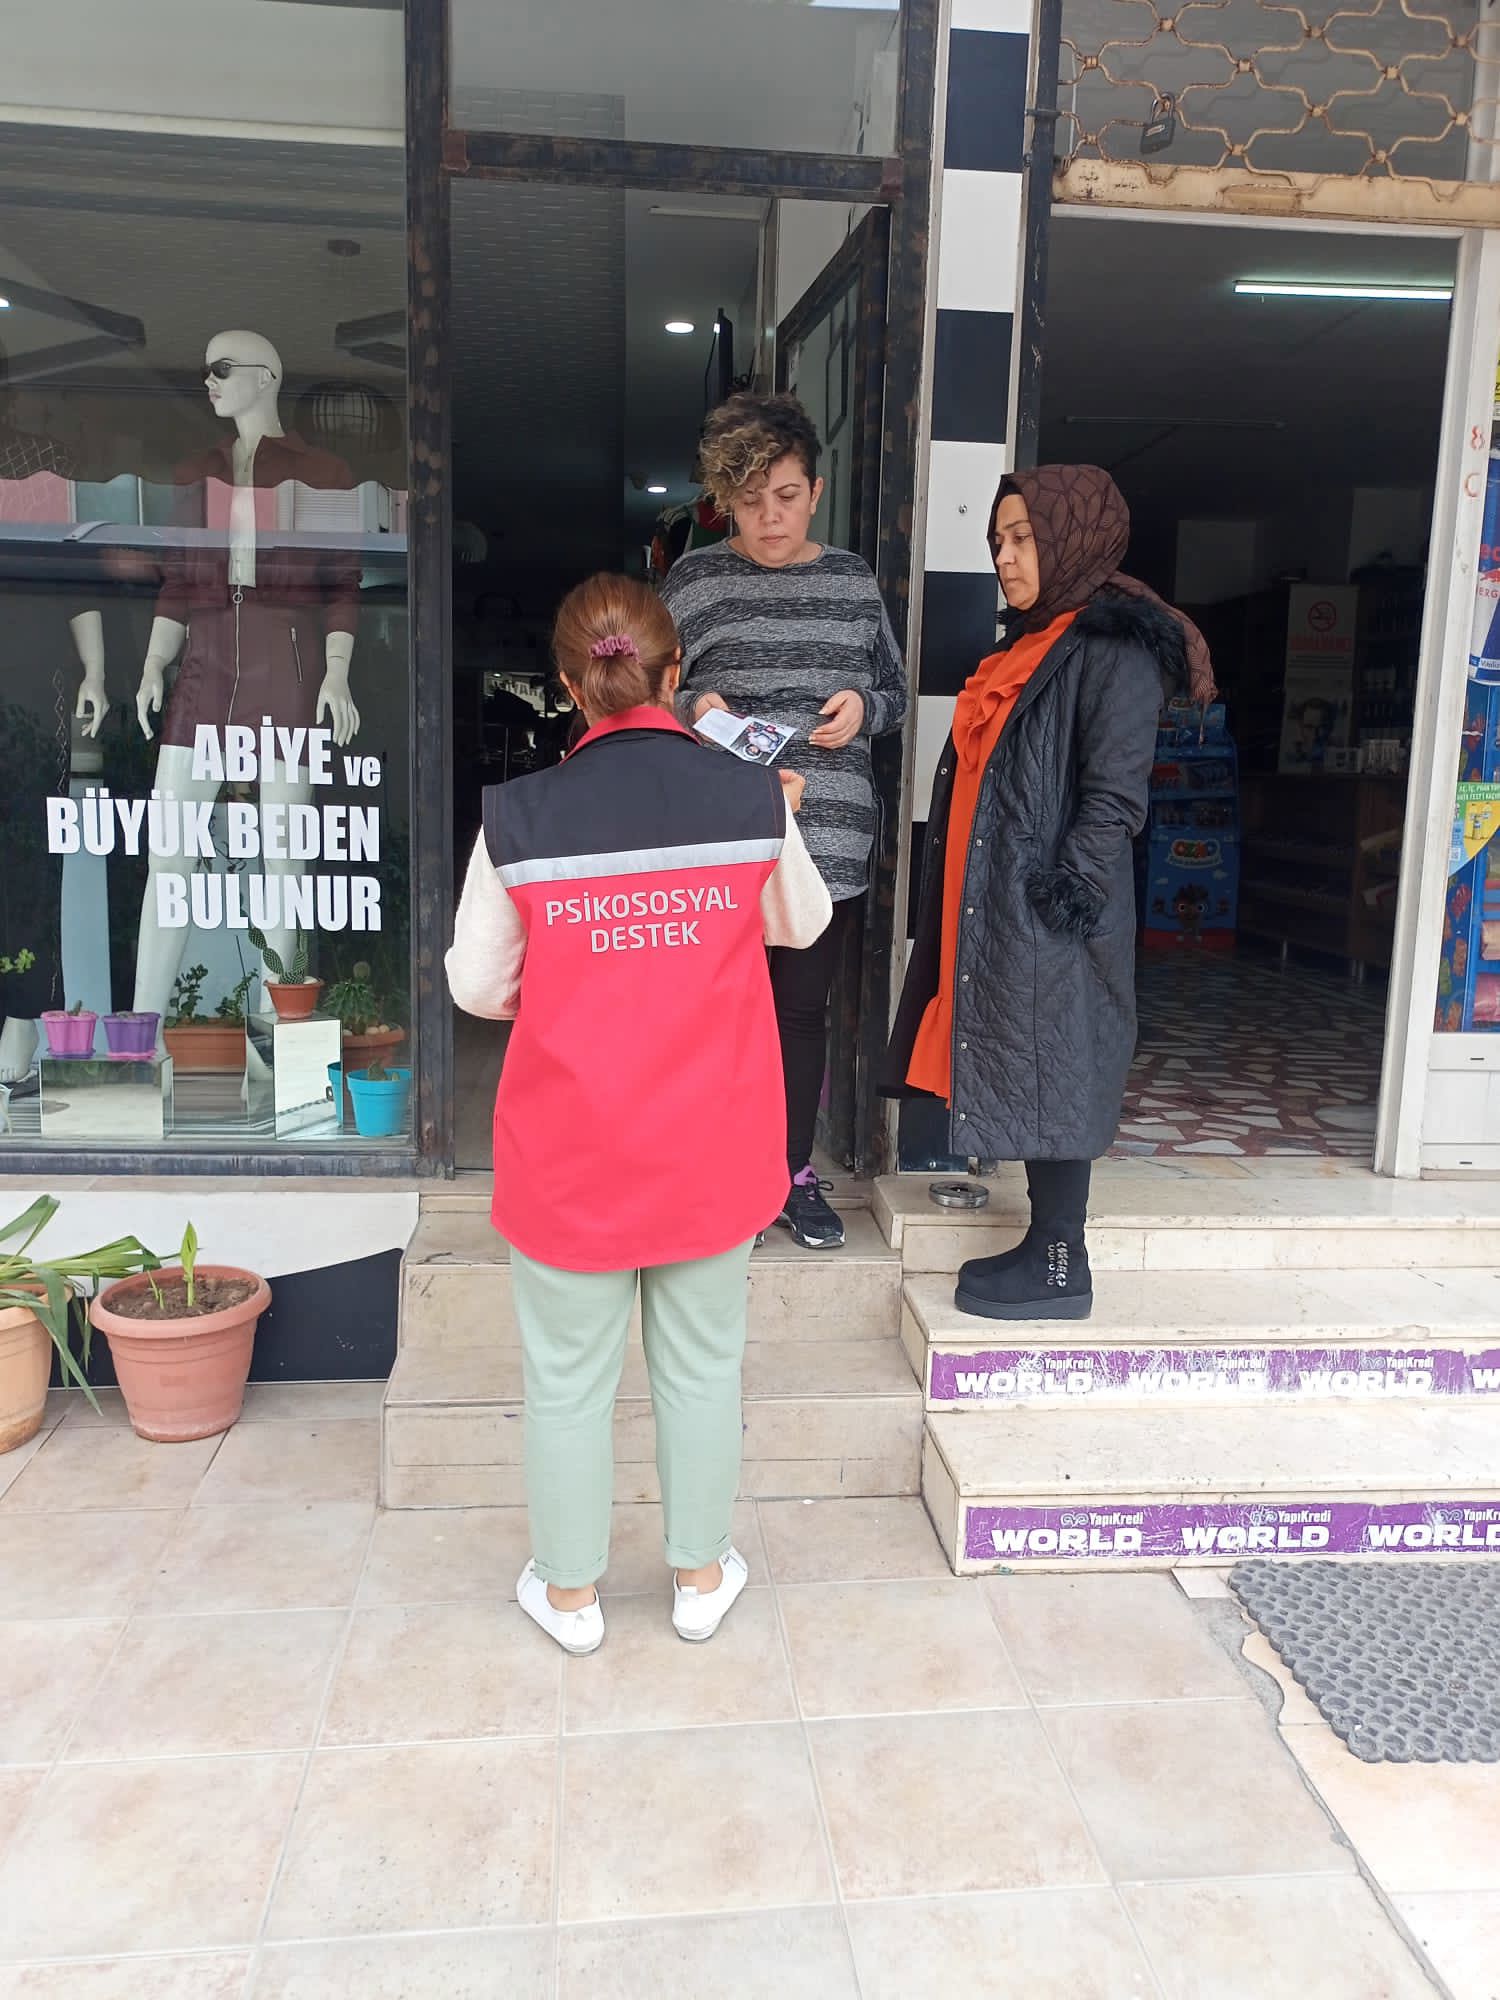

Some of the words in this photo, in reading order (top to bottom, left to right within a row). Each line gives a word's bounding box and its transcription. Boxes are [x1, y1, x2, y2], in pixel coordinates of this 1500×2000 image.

[192, 715, 333, 785] ABİYE
[343, 755, 381, 788] ve
[46, 787, 216, 857] BÜYÜK
[228, 802, 380, 862] BEDEN
[155, 872, 382, 932] BULUNUR
[545, 885, 738, 926] PSİKOSOSYAL
[590, 921, 701, 953] DESTEK
[955, 1372, 1093, 1394] WORLD
[1130, 1371, 1267, 1394] WORLD
[1299, 1370, 1433, 1393] WORLD
[991, 1527, 1143, 1554] WORLD
[1181, 1525, 1330, 1550] WORLD
